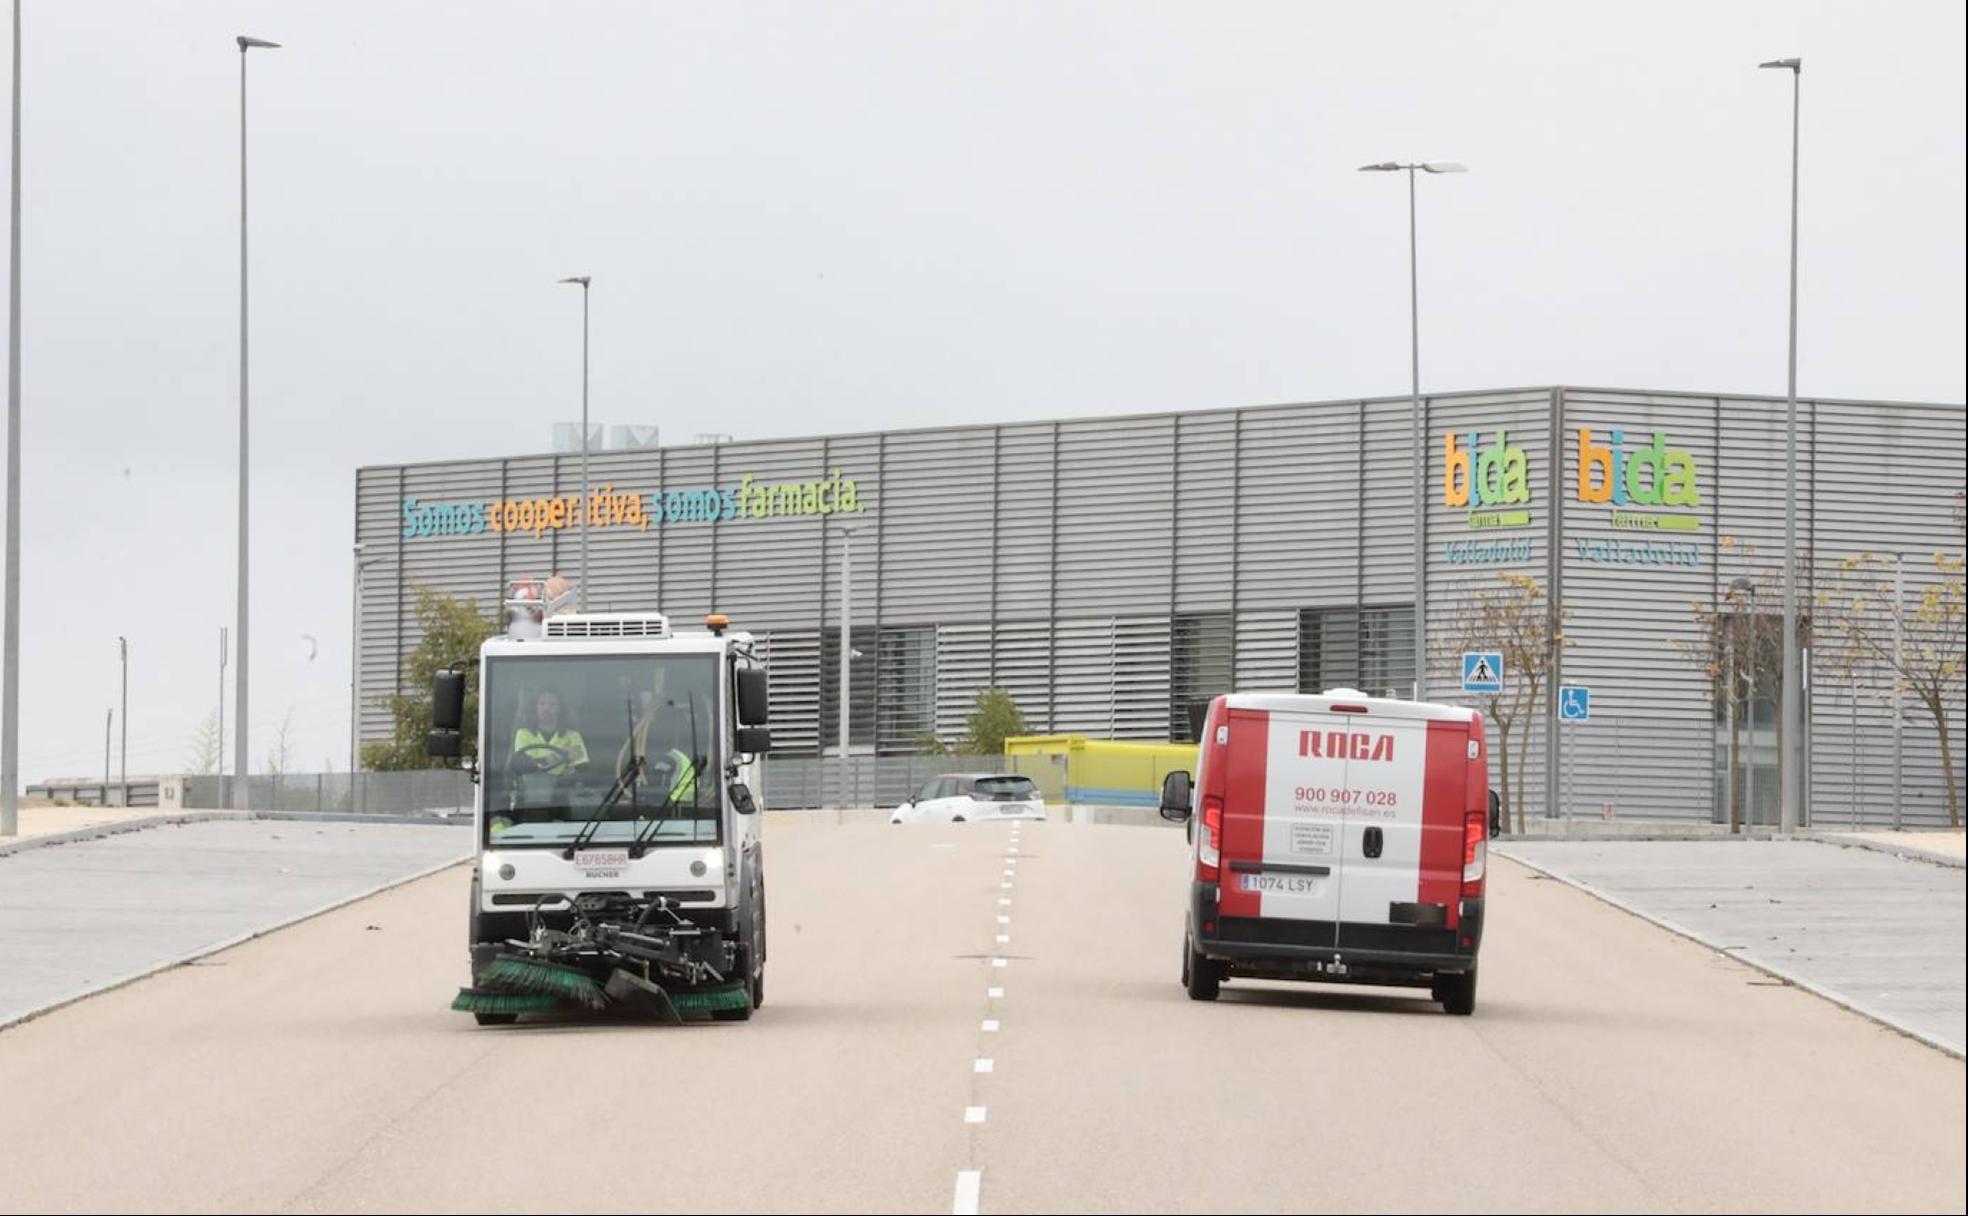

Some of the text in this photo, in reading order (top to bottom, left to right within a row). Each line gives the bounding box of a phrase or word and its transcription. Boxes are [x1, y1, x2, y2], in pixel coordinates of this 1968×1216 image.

[1445, 431, 1530, 506] bida
[1578, 427, 1700, 506] bida
[403, 498, 486, 538] Somos
[649, 485, 737, 524] somos
[1575, 537, 1699, 567] Valladolid
[1298, 729, 1395, 762] ROCA
[1295, 786, 1397, 806] 900 907 028
[585, 870, 620, 879] BUCHER
[1252, 876, 1313, 892] 1074 LSY
